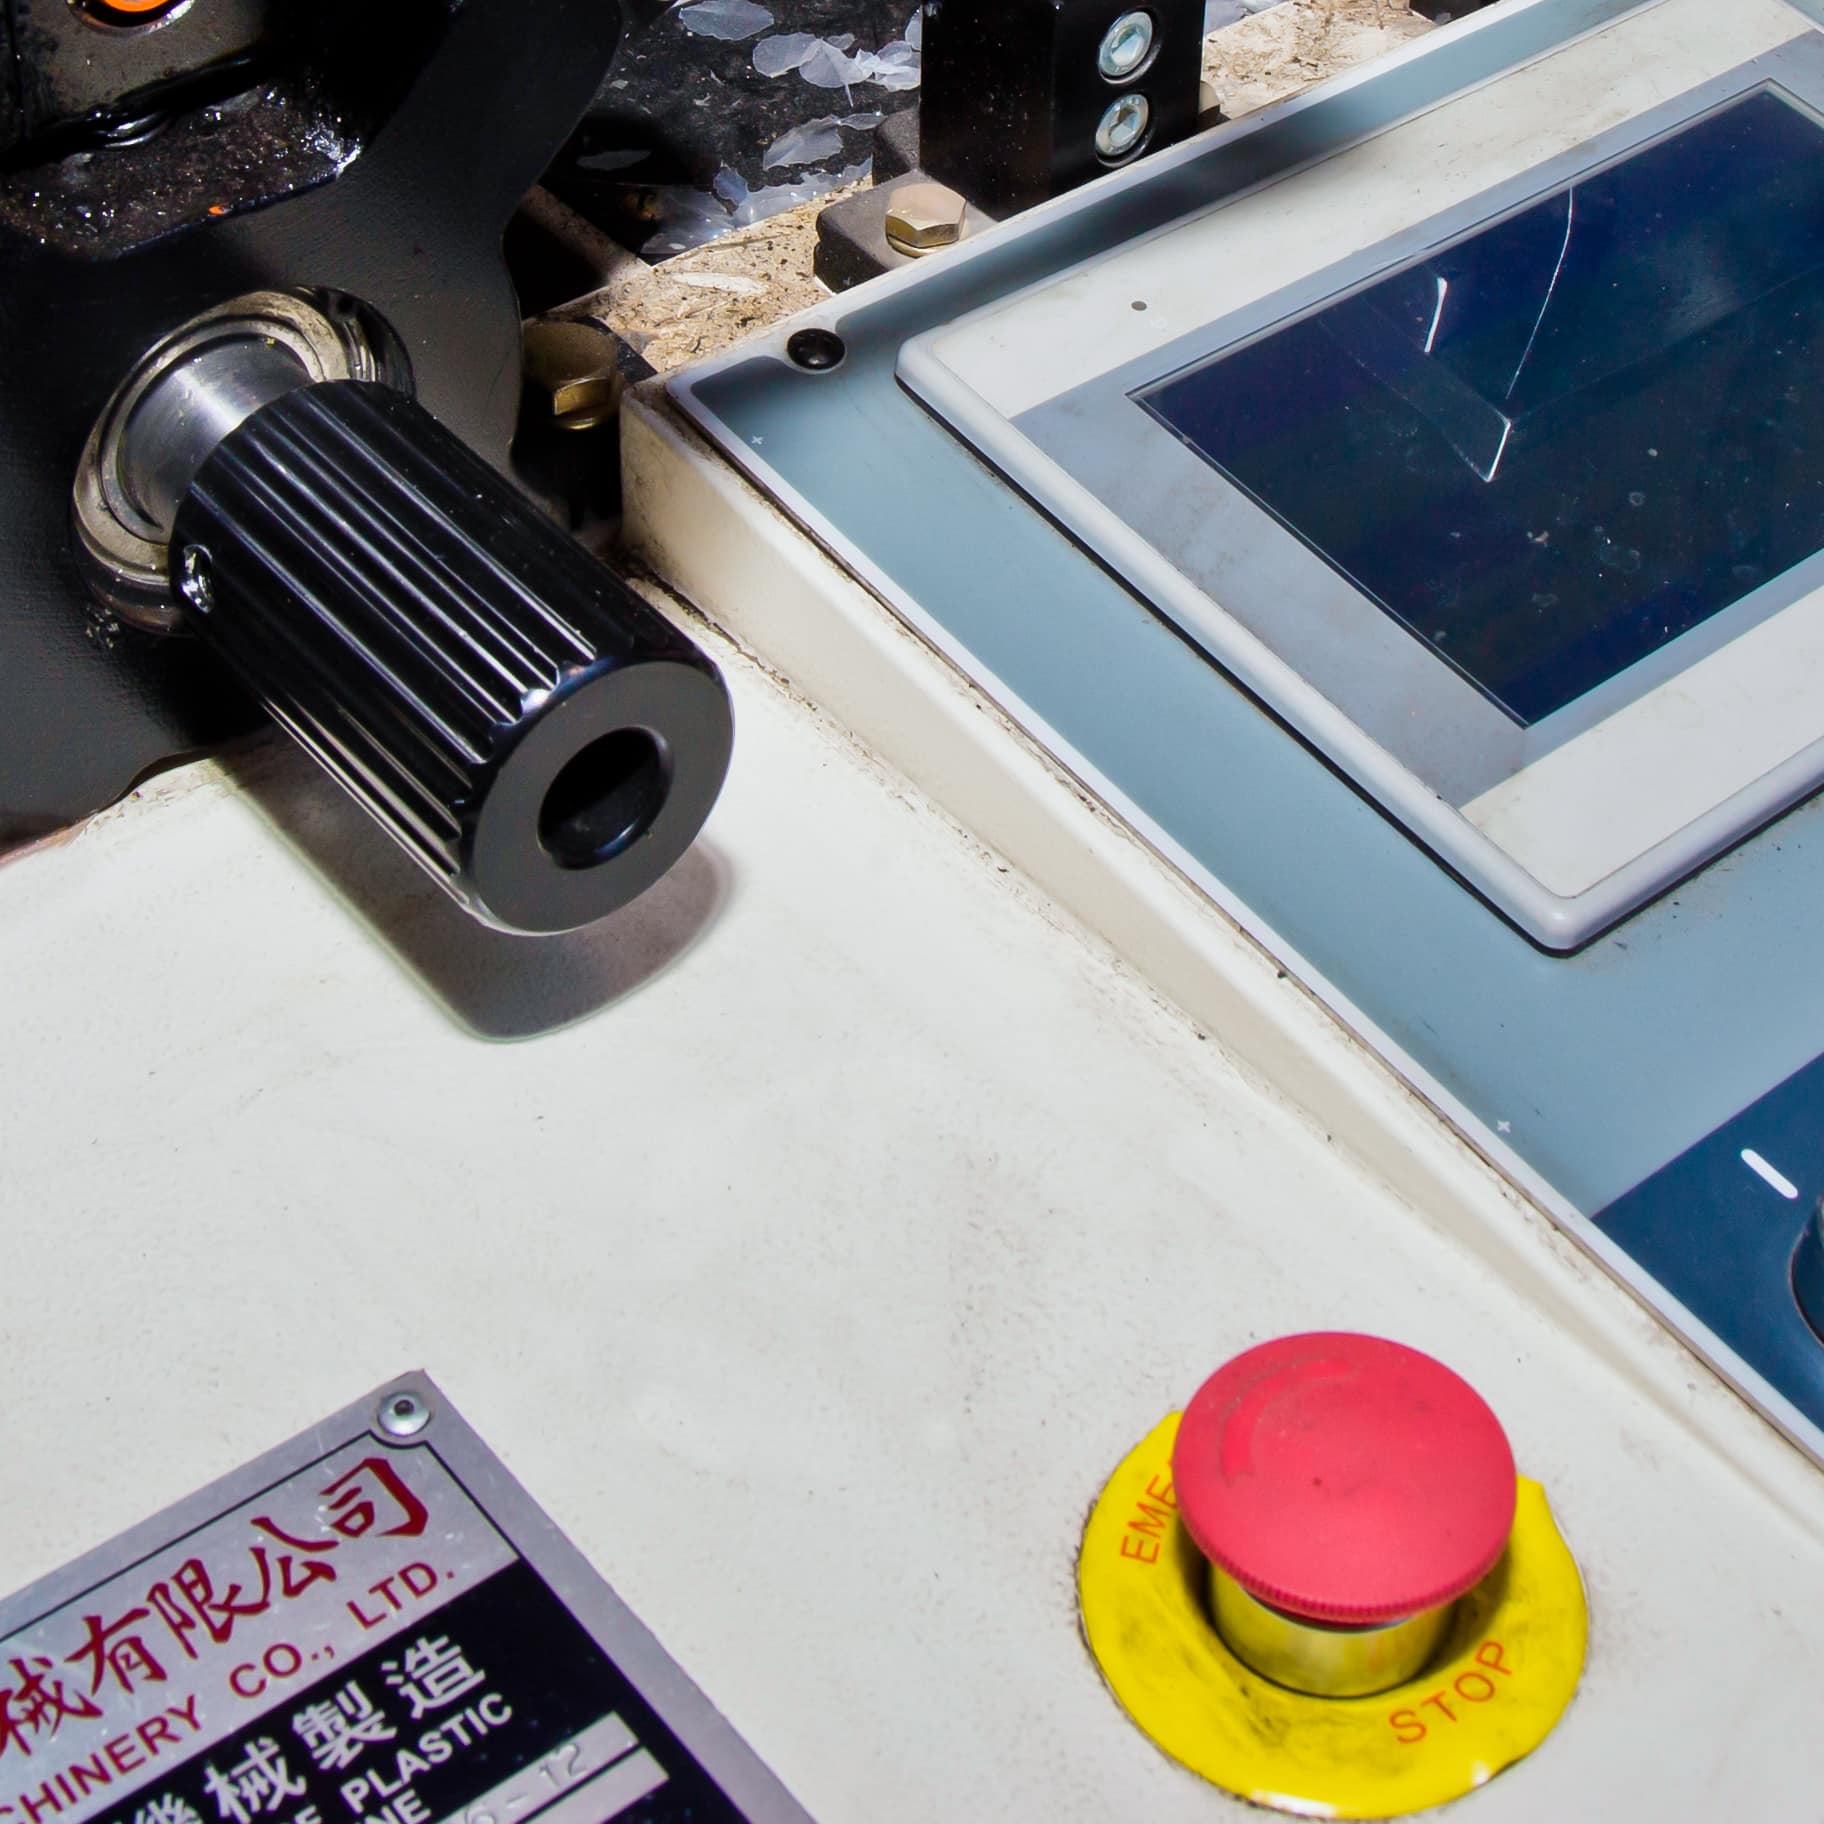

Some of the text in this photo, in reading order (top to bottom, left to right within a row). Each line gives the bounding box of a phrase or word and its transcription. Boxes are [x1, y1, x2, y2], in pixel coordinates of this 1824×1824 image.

[229, 1642, 336, 1699] CO.,
[346, 1561, 456, 1630] LTD.
[1388, 1638, 1516, 1744] STOP
[340, 1692, 513, 1815] PLASTIC
